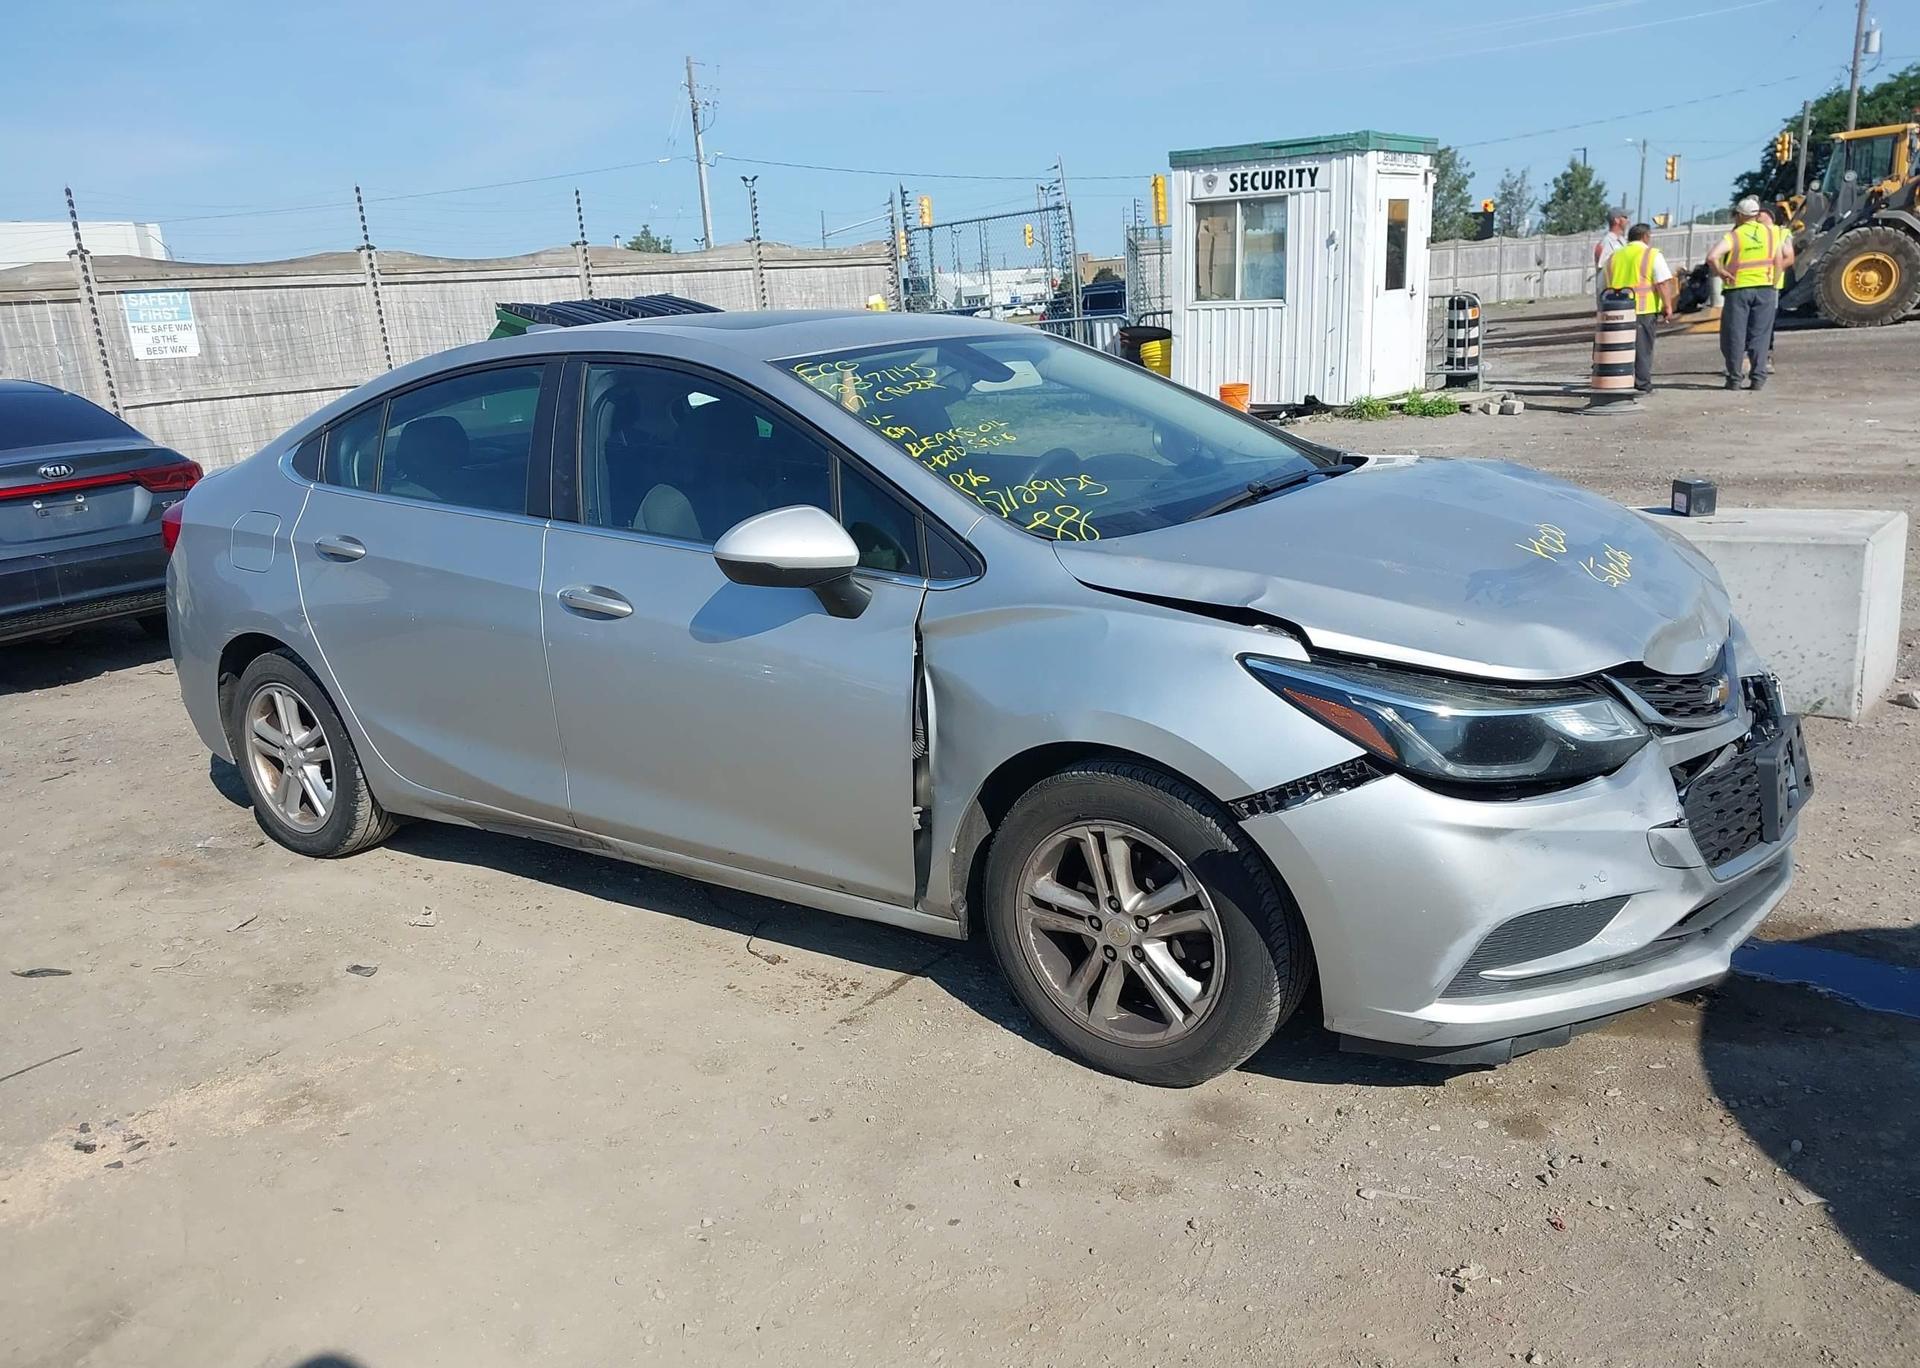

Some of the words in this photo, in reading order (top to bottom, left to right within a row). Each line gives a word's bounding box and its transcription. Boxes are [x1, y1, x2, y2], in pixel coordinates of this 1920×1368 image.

[1229, 167, 1320, 193] SECURITY
[128, 292, 184, 307] SAFETY
[139, 308, 181, 321] FIRST
[132, 325, 150, 334] THE
[151, 323, 174, 333] SAFE
[175, 323, 193, 332] WAY
[152, 335, 160, 344] IS
[161, 335, 179, 343] THE
[146, 346, 168, 355] BEST
[170, 345, 188, 353] WAY
[46, 464, 69, 477] KIA
